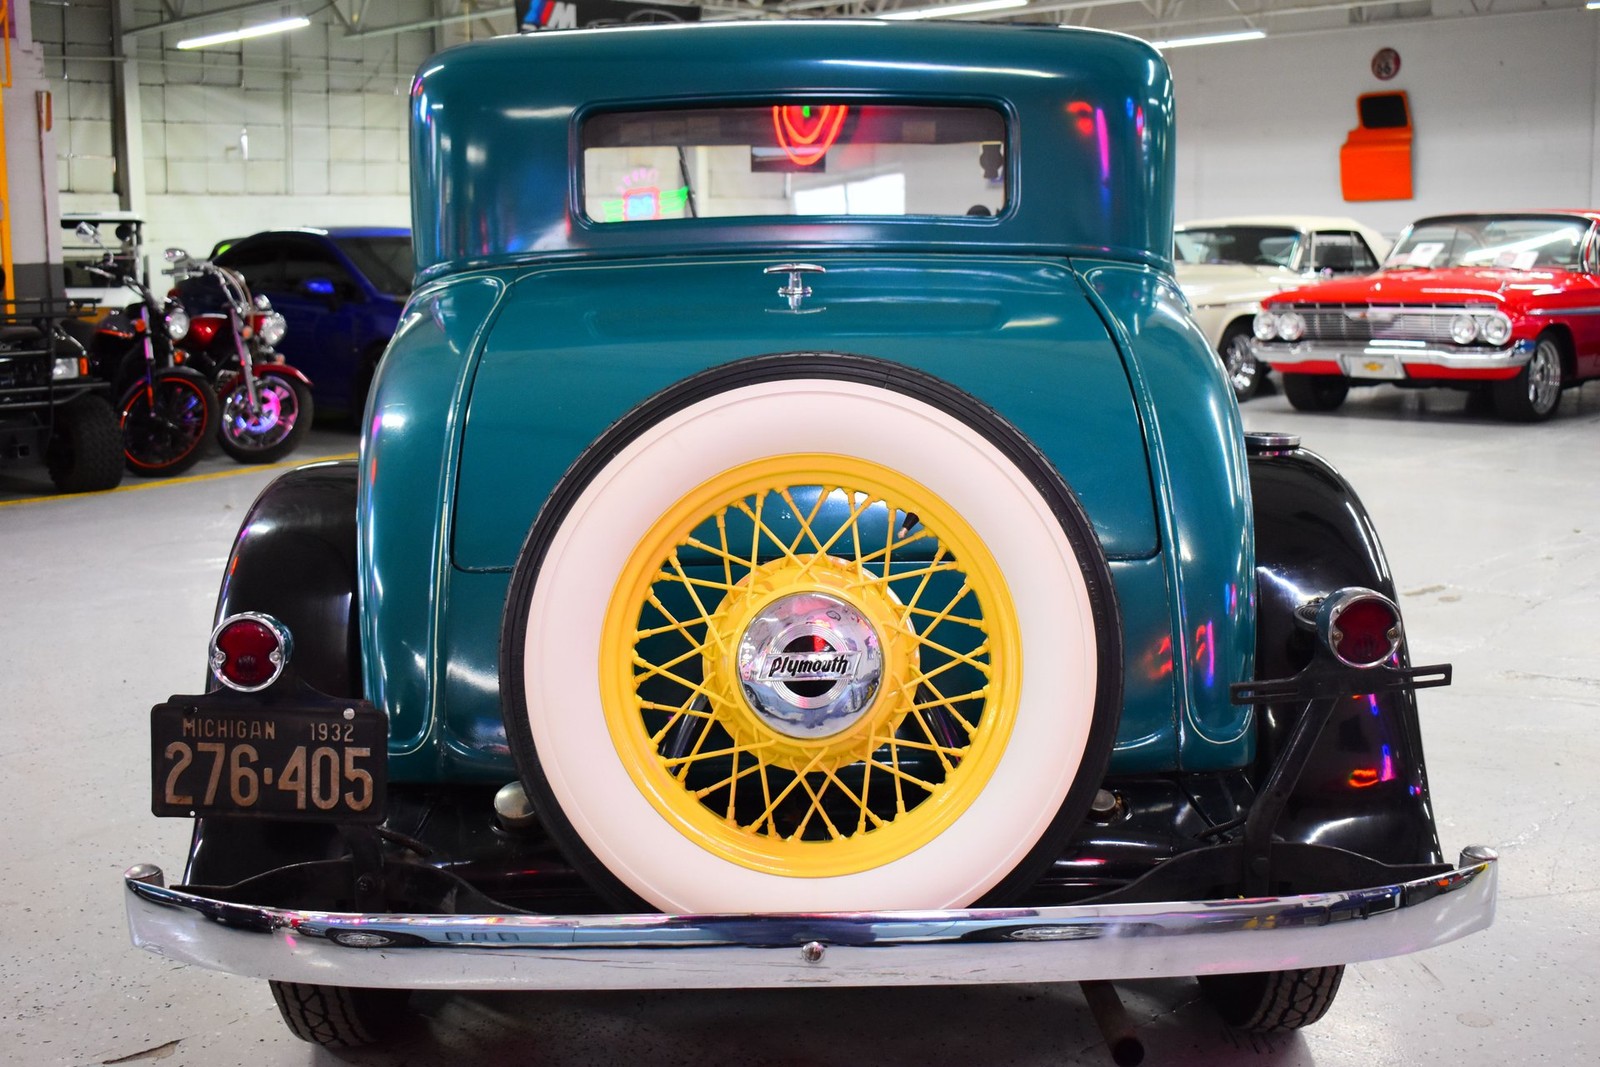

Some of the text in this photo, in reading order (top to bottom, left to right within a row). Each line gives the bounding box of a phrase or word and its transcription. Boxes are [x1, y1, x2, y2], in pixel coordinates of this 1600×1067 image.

[768, 654, 849, 678] Plymouth
[182, 718, 354, 743] MICHIGAN 1932
